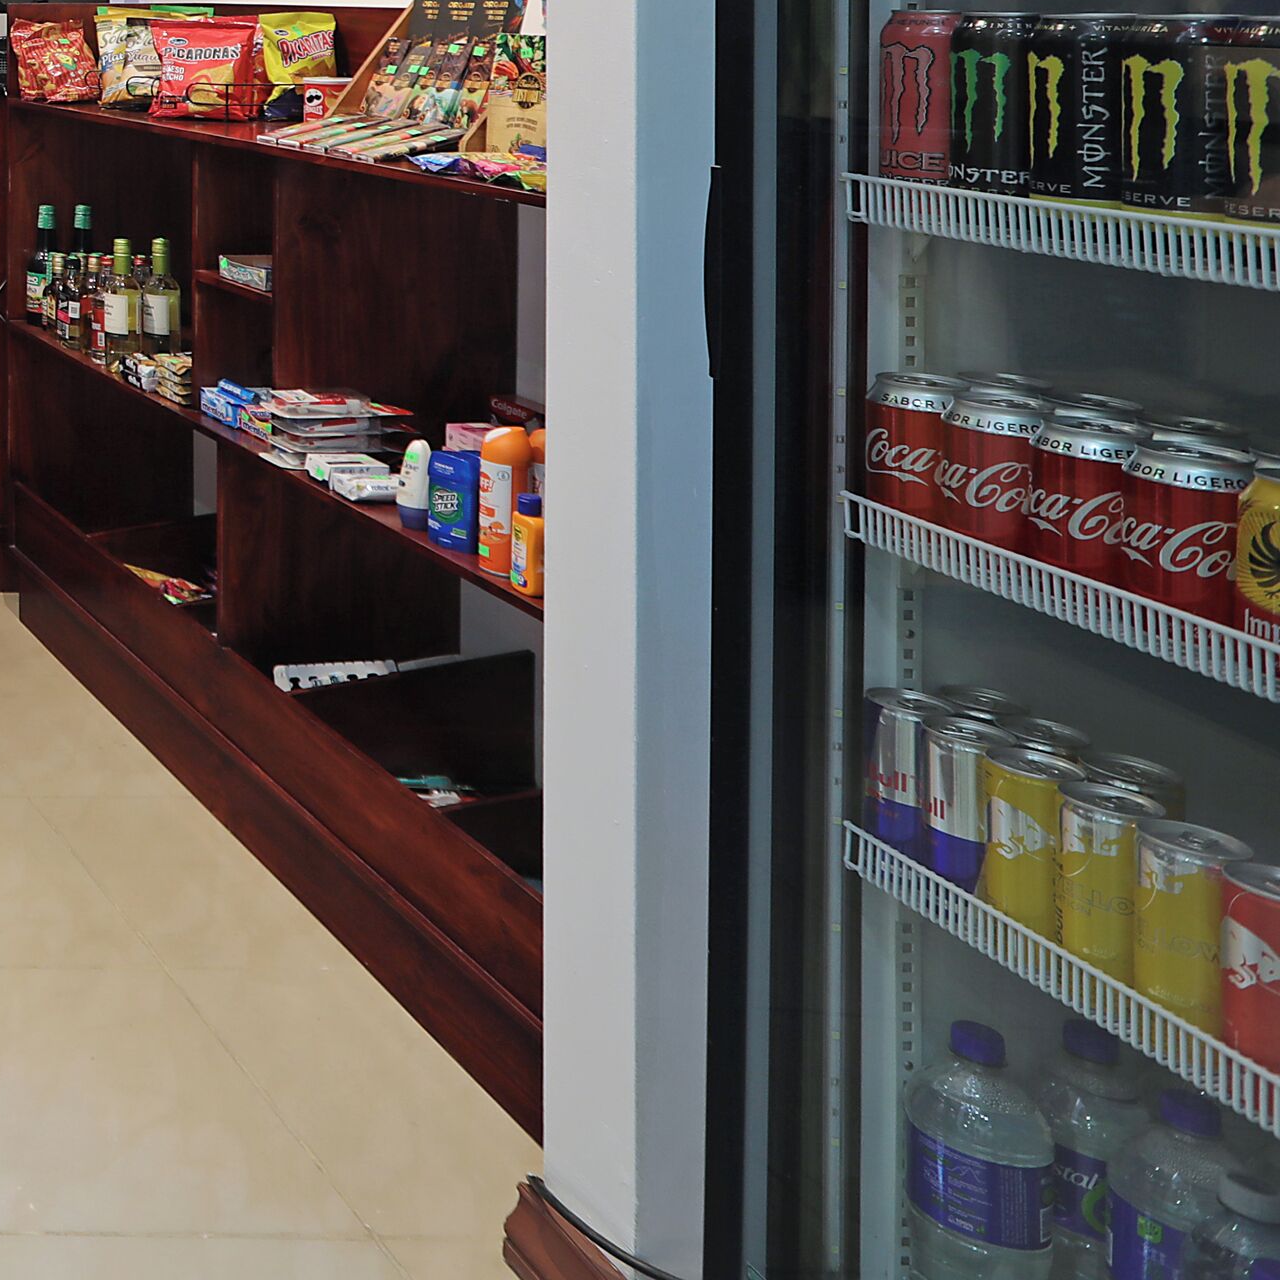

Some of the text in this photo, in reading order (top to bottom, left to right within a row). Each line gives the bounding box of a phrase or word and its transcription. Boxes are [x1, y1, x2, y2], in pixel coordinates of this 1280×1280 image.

[163, 45, 241, 61] PICARONAS
[1077, 46, 1112, 189] MONSTER
[881, 393, 936, 409] SABOR
[201, 402, 226, 418] mentos
[491, 399, 529, 420] Colgate
[242, 422, 269, 439] mentos
[433, 493, 457, 503] SPEED
[435, 503, 459, 512] STICK
